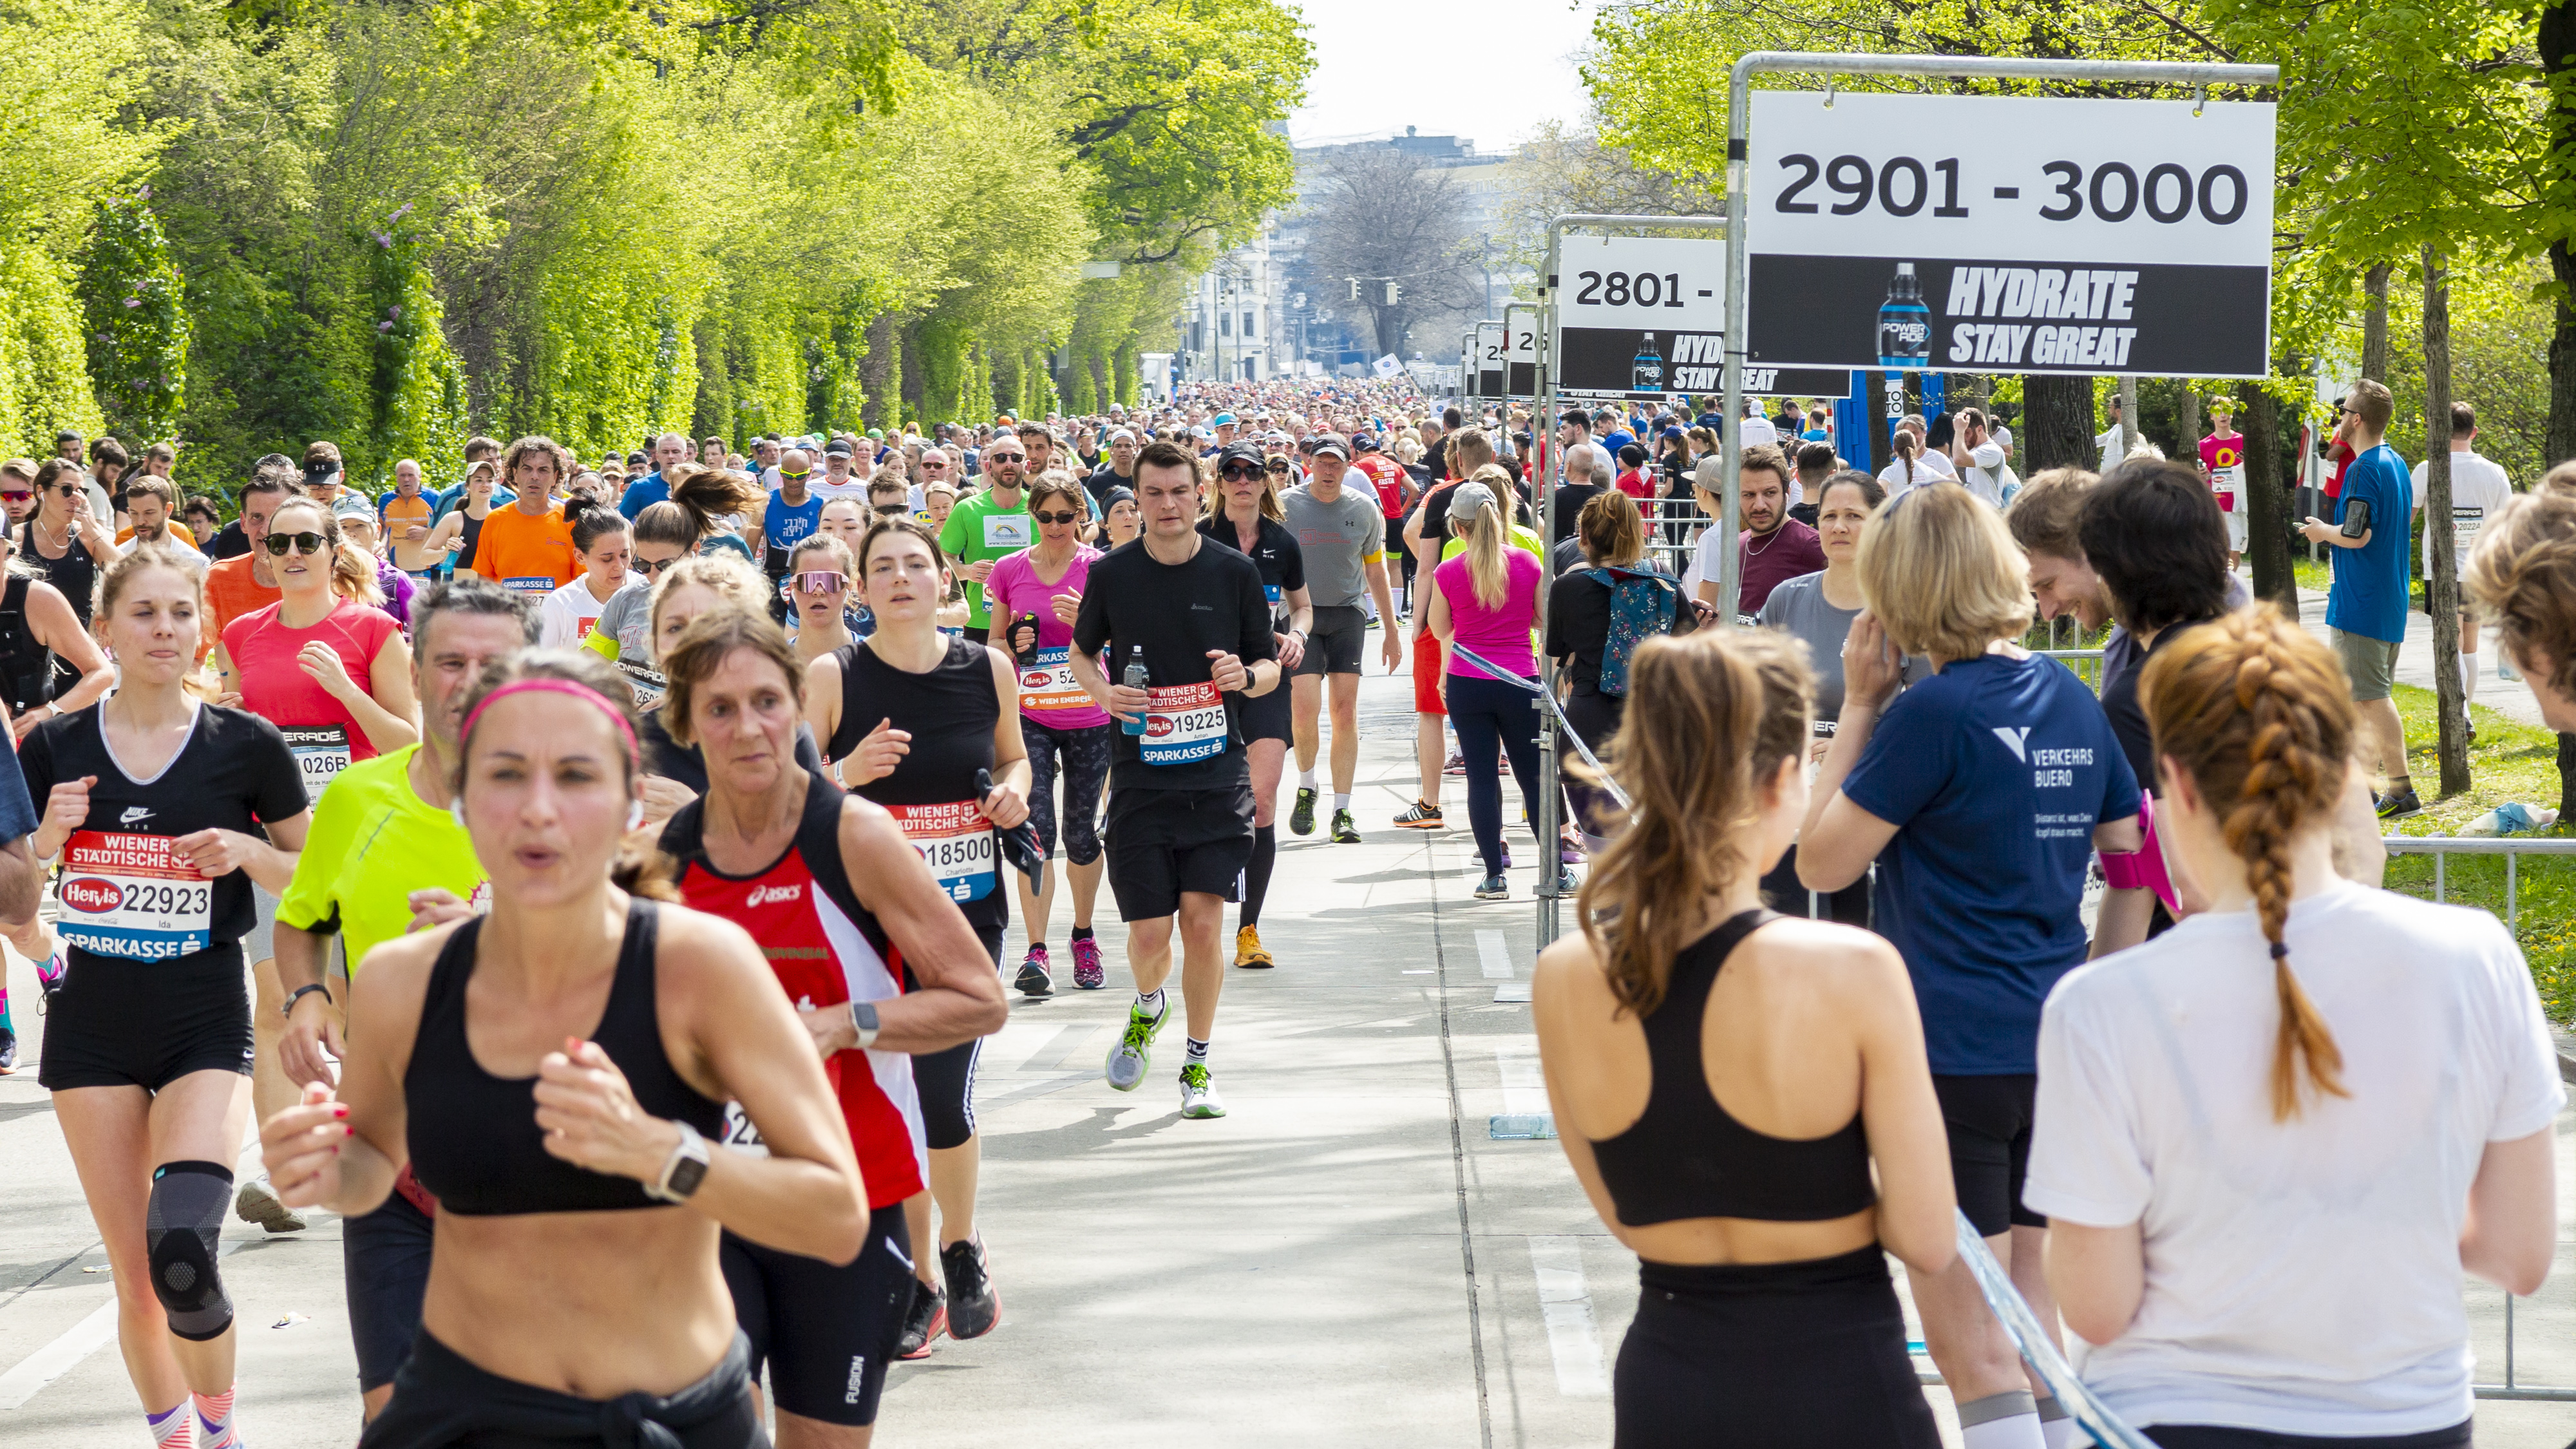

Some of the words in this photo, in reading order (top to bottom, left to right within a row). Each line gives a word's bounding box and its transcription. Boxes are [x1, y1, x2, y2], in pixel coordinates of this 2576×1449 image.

[1776, 153, 1969, 218] 2901
[1993, 187, 2020, 199] -
[2039, 160, 2248, 225] 3000
[1576, 270, 1685, 308] 2801
[1946, 267, 2139, 321] HYDRATE
[1882, 323, 1926, 332] POWER
[1899, 332, 1926, 342] ADE
[1671, 334, 1725, 363] HYD
[1949, 324, 2032, 365] STAY
[2031, 327, 2137, 367] GREAT
[1673, 366, 1720, 390] STAY
[503, 580, 544, 589] SPARKASSE
[1025, 676, 1050, 685] Hervis
[636, 690, 659, 705] 26
[1060, 695, 1093, 703] ENERGIE
[1158, 685, 1197, 697] WIENER
[1175, 709, 1224, 733] 19225
[1144, 744, 1211, 762] SPARKASSE
[2031, 748, 2094, 767] VERKEHRS
[2034, 769, 2073, 788] BUERO
[126, 806, 149, 817] NIKE
[906, 804, 960, 819] WIENER
[104, 835, 170, 853] WIENER
[927, 837, 991, 867] 18500
[73, 848, 169, 868] STÄDTISCHE
[945, 867, 974, 876] Charlotte
[67, 884, 119, 907] Hervis
[123, 884, 208, 915] 22923
[158, 920, 171, 929] Ida
[64, 933, 178, 958] SPARKASSE
[845, 1356, 864, 1404] FUSION
